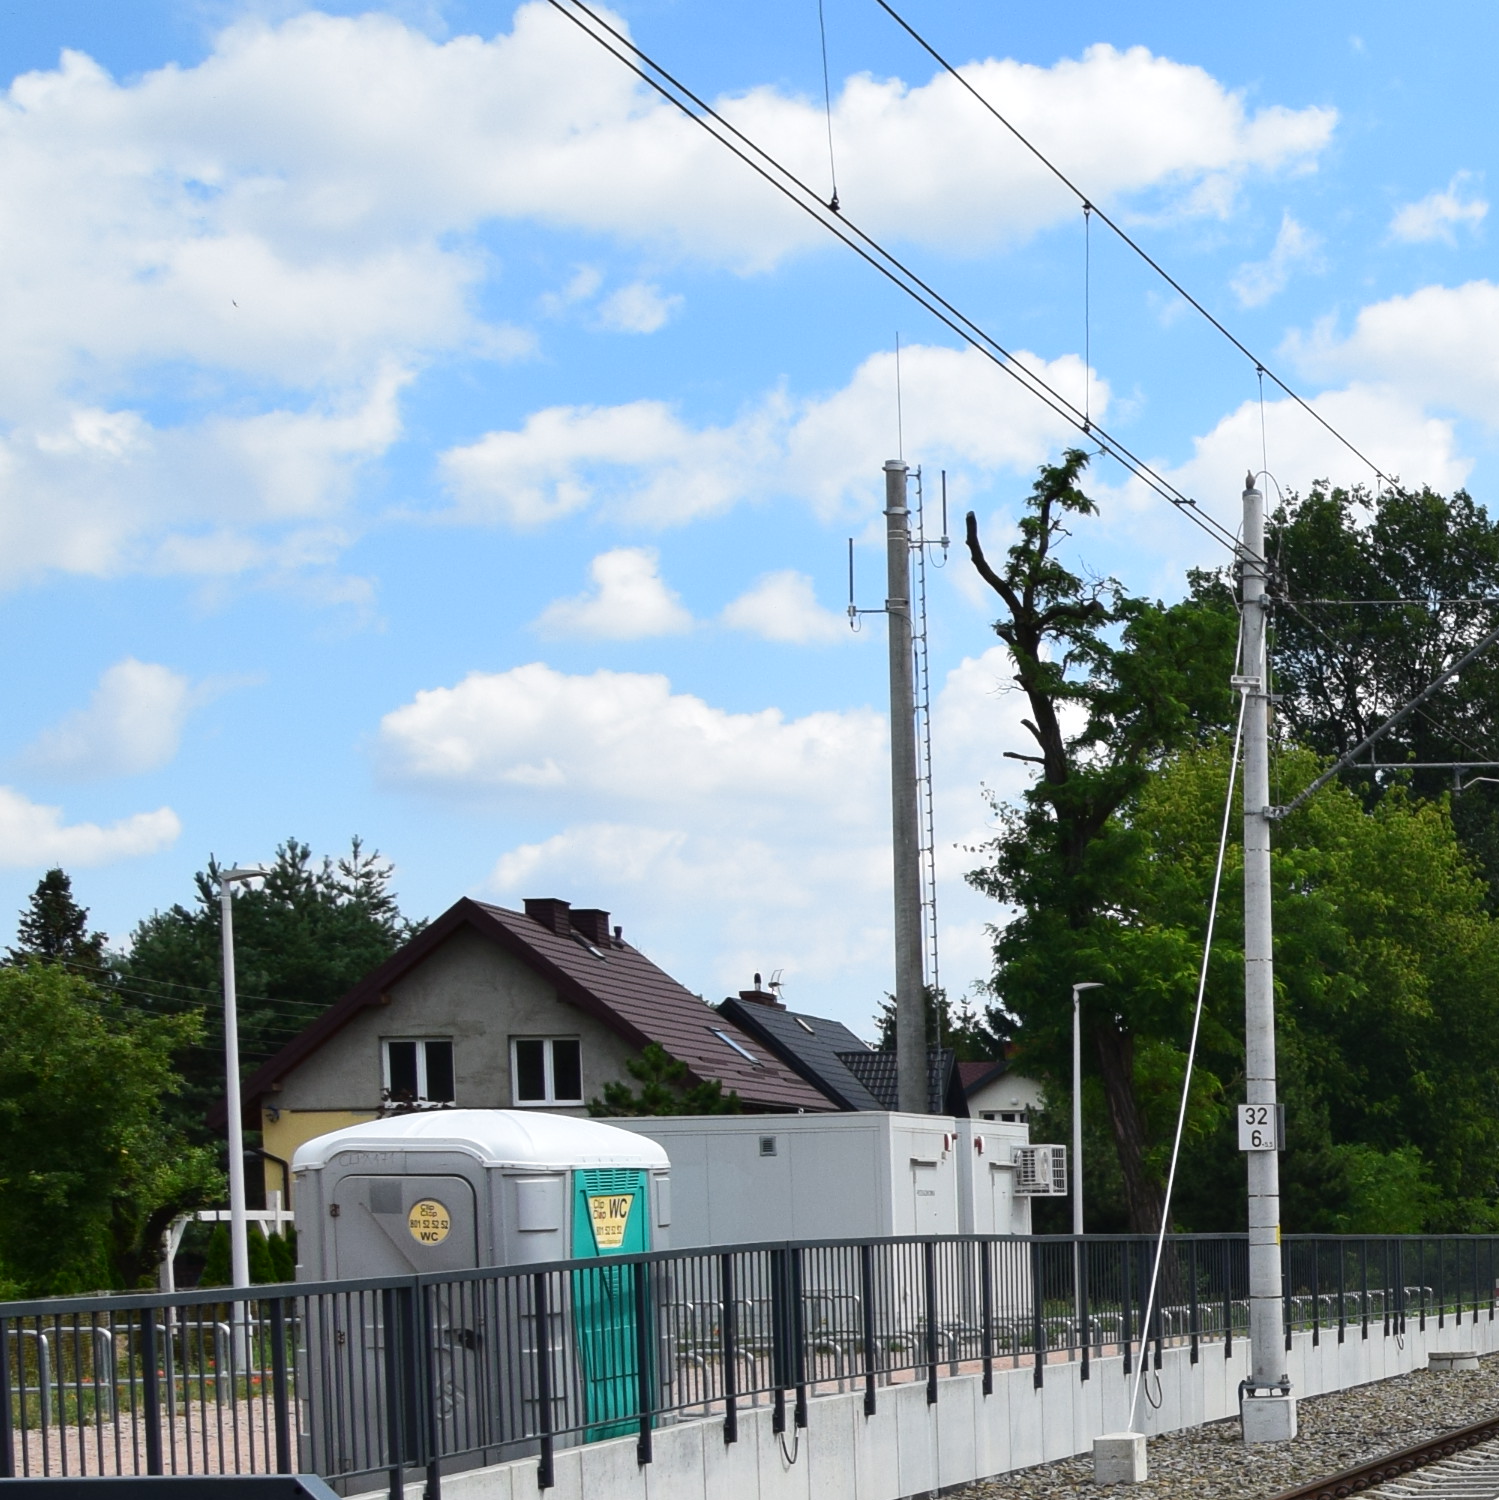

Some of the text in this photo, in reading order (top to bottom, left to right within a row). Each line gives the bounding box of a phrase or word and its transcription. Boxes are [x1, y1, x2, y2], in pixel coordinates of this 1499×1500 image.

[1245, 1107, 1268, 1125] 32
[1251, 1130, 1262, 1147] 6
[609, 1198, 628, 1219] WC
[422, 1219, 430, 1229] 52
[431, 1220, 439, 1229] 52
[440, 1220, 449, 1229] 52
[420, 1231, 439, 1241] WC
